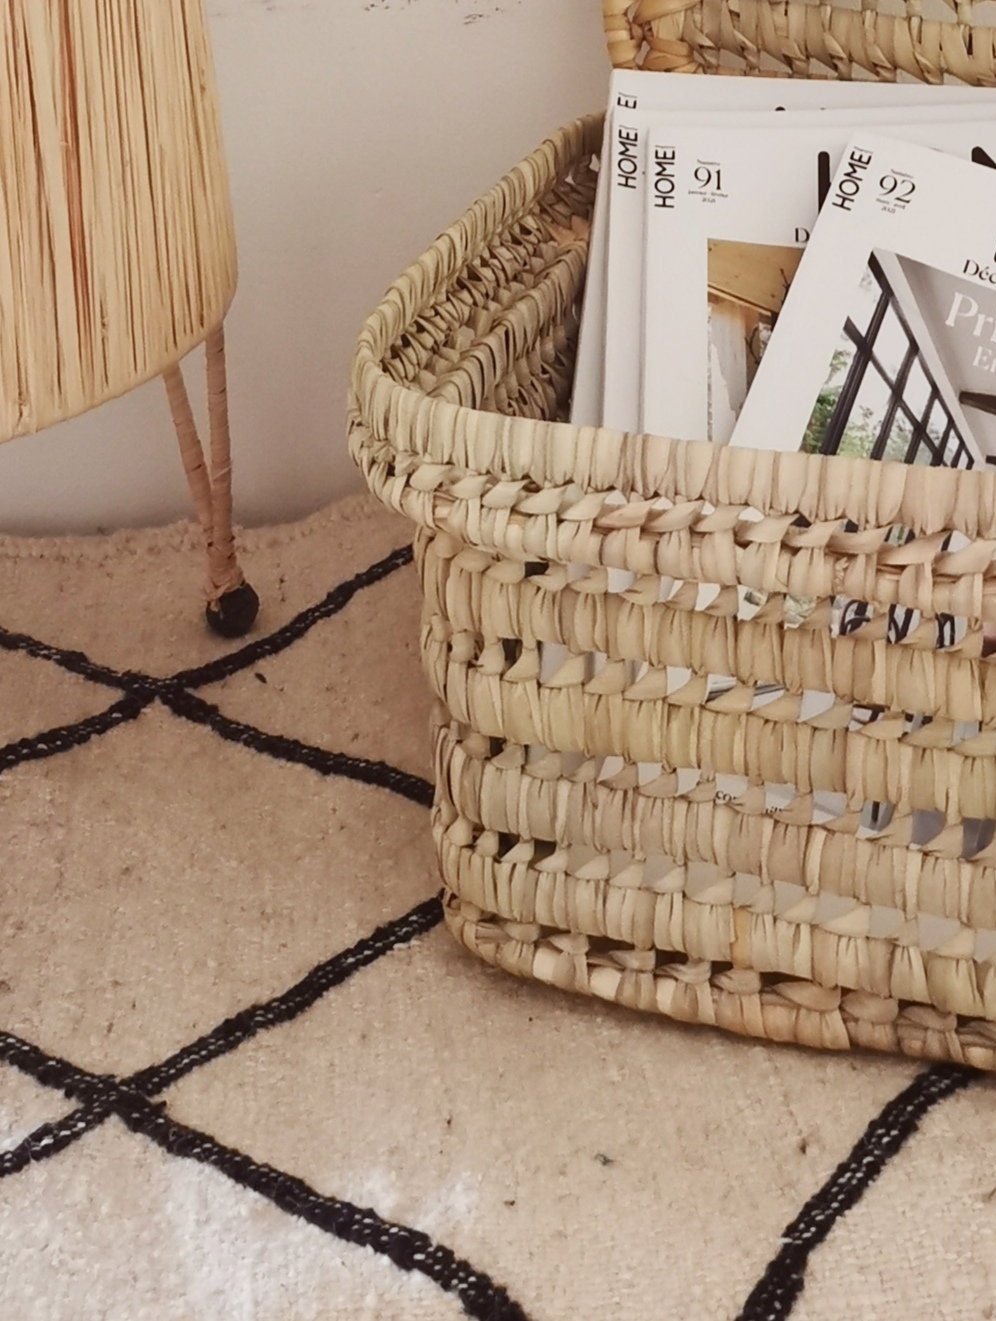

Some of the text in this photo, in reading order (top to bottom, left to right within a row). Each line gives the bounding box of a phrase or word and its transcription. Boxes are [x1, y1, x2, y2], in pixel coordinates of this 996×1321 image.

[617, 129, 638, 189] HOME
[654, 149, 676, 208] HOME
[694, 166, 721, 190] 91
[832, 151, 872, 211] HOME
[879, 174, 916, 204] 92
